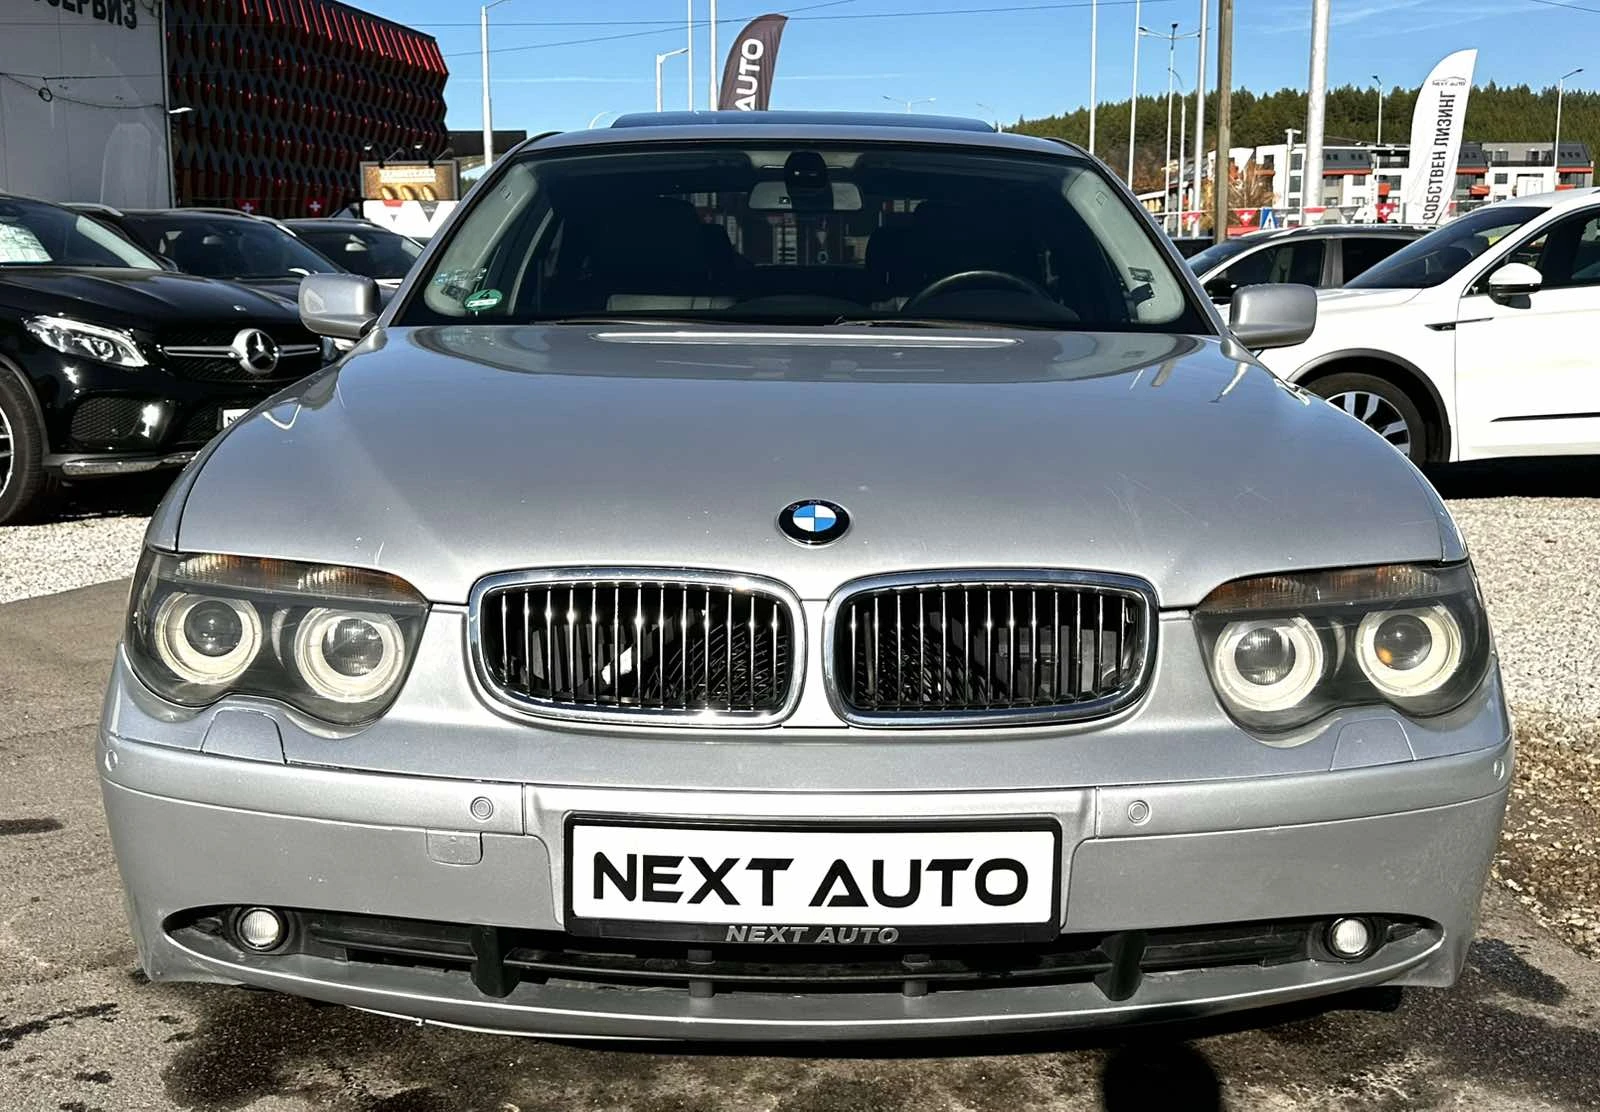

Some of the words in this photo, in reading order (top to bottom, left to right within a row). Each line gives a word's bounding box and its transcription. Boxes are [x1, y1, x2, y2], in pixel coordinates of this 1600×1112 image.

[735, 39, 764, 110] AUTO
[1422, 151, 1446, 220] СОБСТВЕН
[1434, 90, 1456, 147] ЛИЗИНГ
[593, 851, 794, 906] NEXT
[807, 857, 1029, 908] AUTO
[725, 925, 809, 943] NEXT
[814, 927, 899, 944] AUTO
